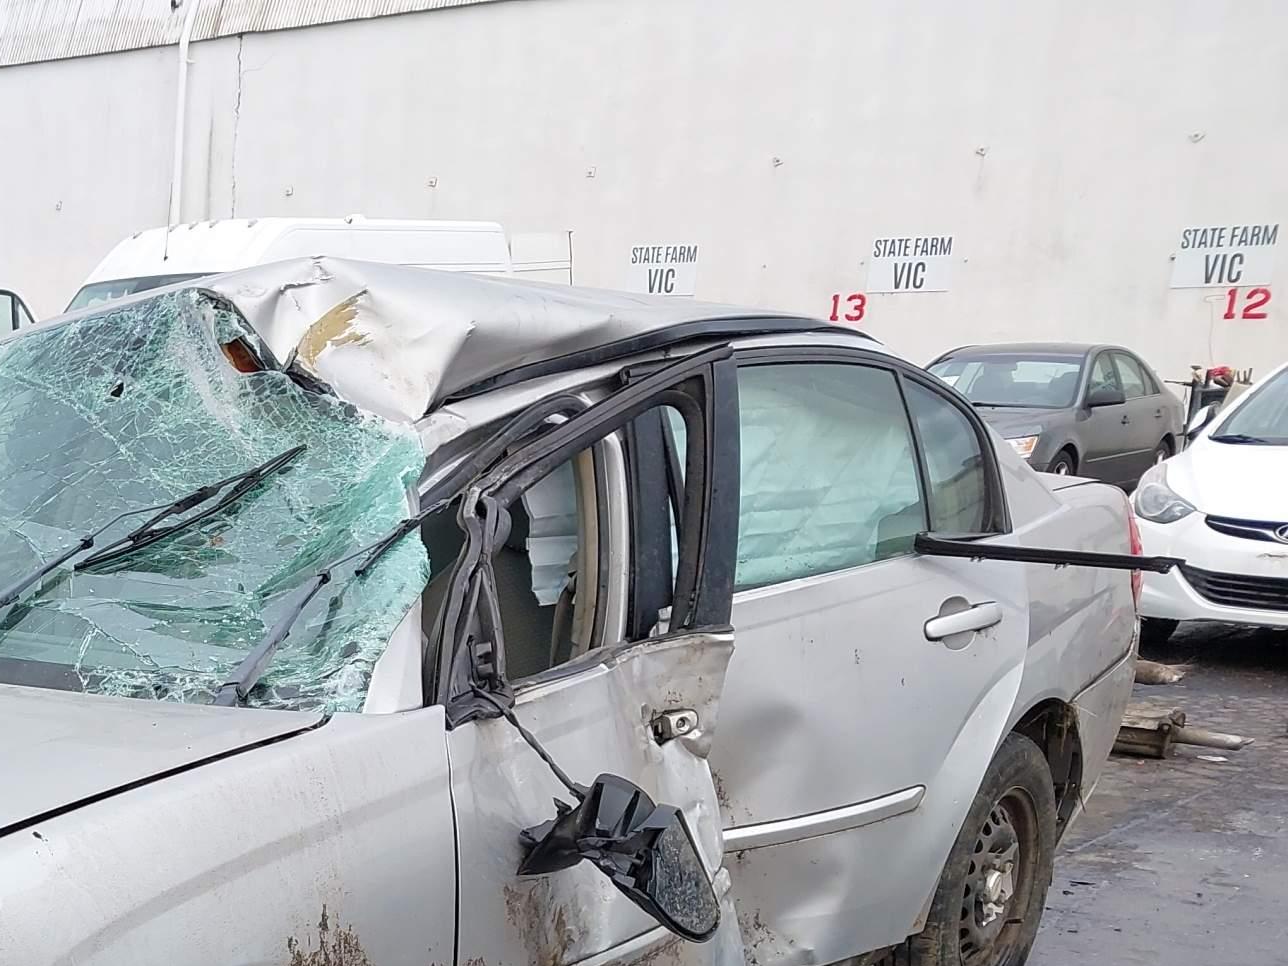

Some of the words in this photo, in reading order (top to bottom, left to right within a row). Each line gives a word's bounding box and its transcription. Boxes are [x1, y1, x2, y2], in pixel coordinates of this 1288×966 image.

[873, 238, 912, 258] STATE
[913, 236, 953, 257] FARM
[1181, 226, 1227, 249] STATE
[1229, 223, 1279, 247] FARM
[631, 246, 663, 265] STATE
[664, 245, 698, 264] FARM
[1204, 252, 1244, 284] VIC
[648, 268, 676, 294] VIC
[893, 261, 926, 290] VIC
[829, 293, 867, 322] 13
[1223, 287, 1272, 320] 12
